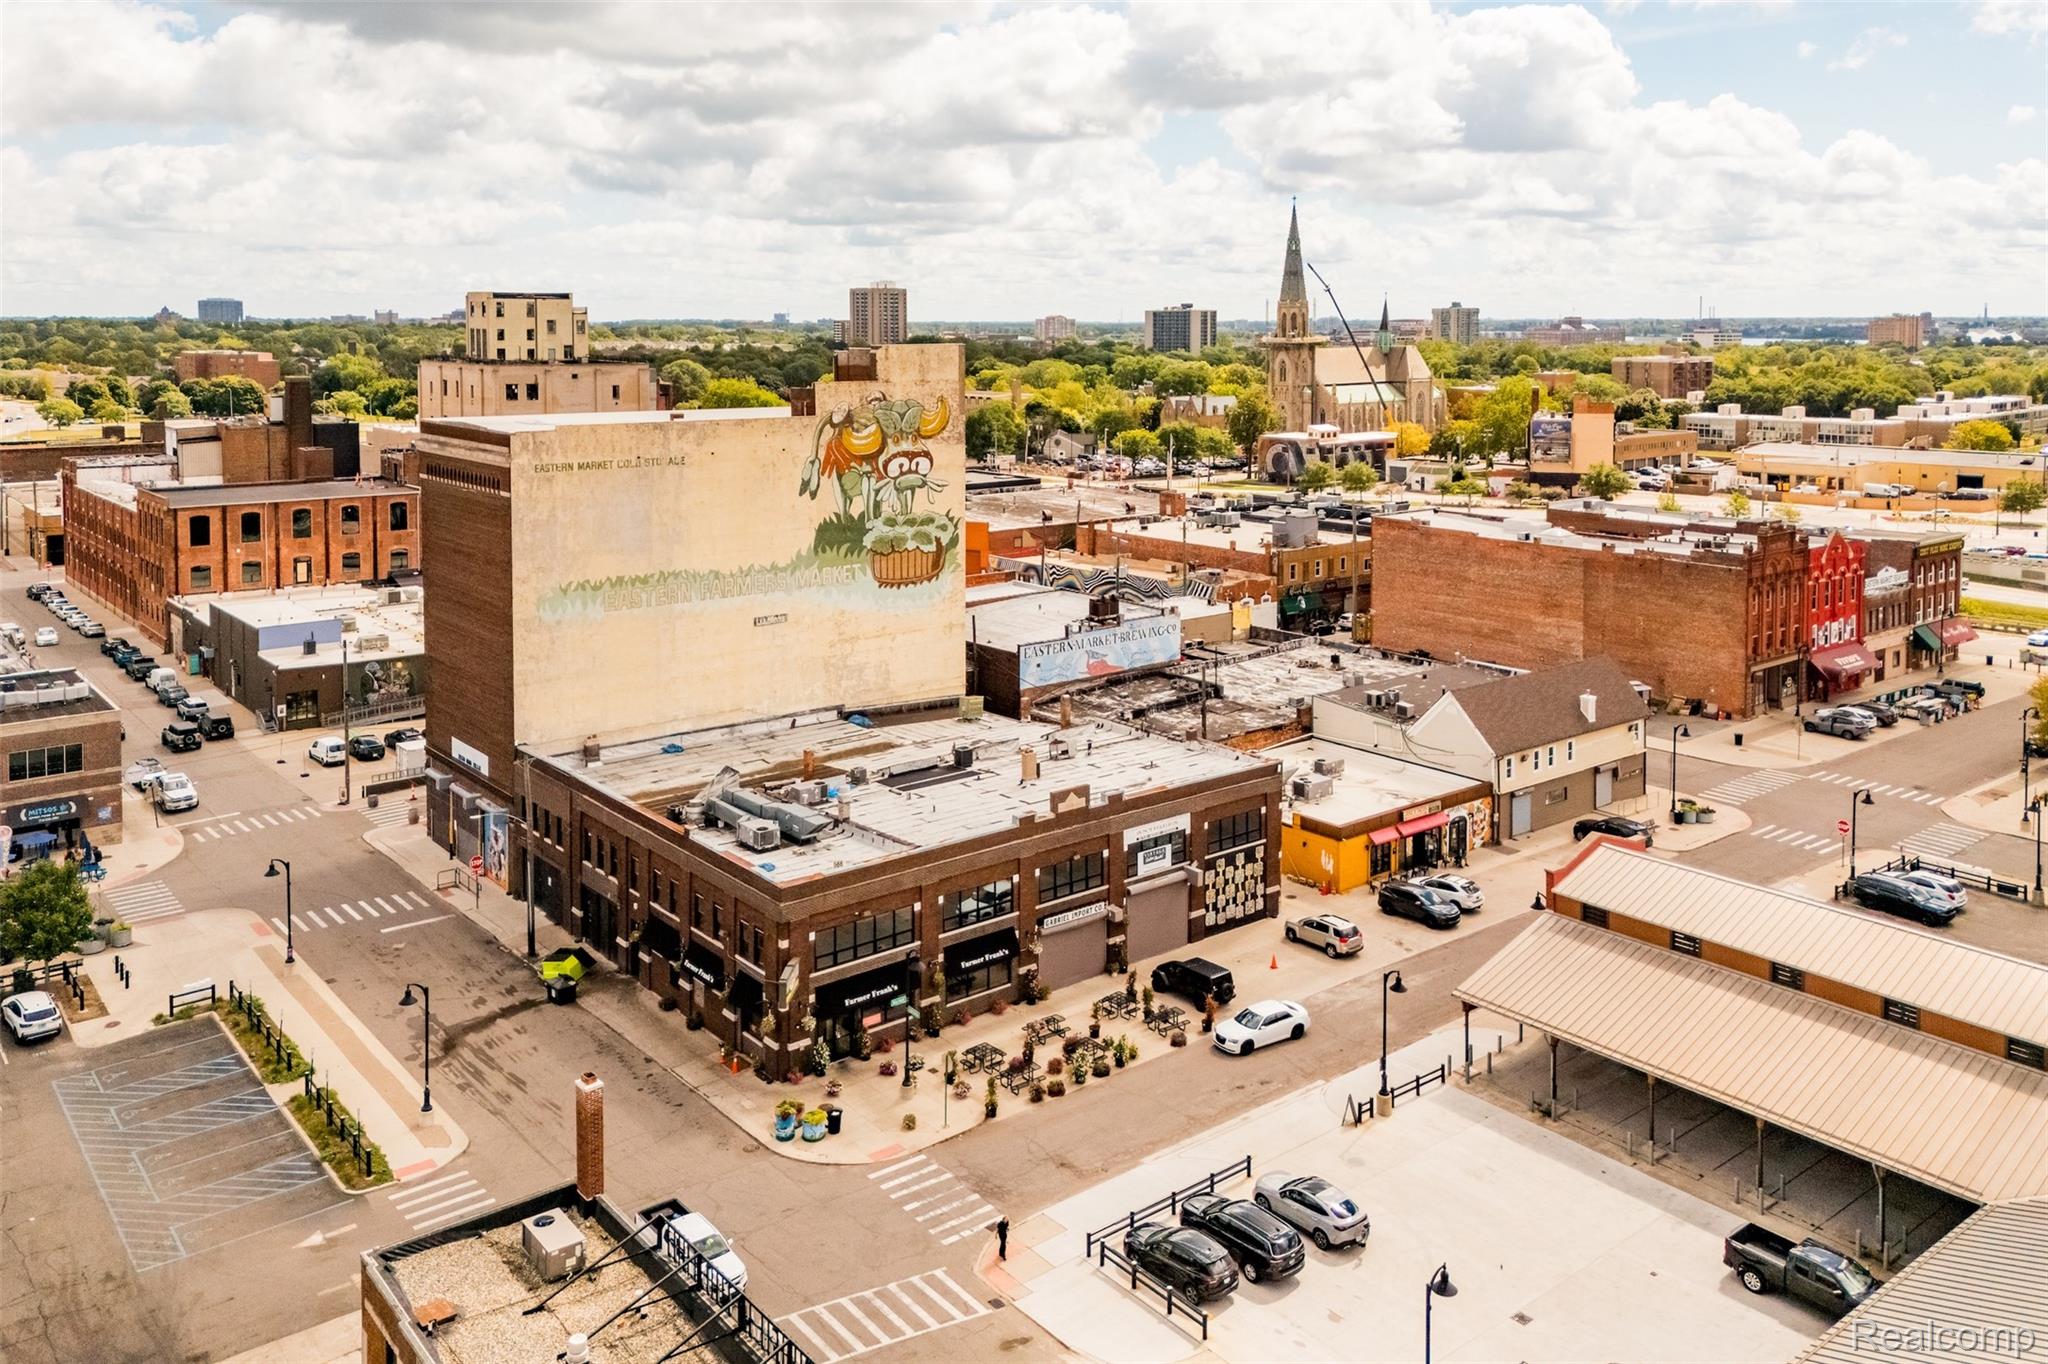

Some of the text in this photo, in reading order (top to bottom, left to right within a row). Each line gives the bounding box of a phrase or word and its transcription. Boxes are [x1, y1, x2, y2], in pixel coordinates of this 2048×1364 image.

[535, 462, 574, 473] EASTERN
[578, 460, 614, 471] MARKET
[603, 563, 862, 612] EASTERN FARMERS MARKET
[28, 805, 57, 817] MITSOS
[1045, 914, 1070, 927] GABRIEL
[1071, 907, 1093, 919] IMPORT
[844, 991, 871, 1007] Farmer
